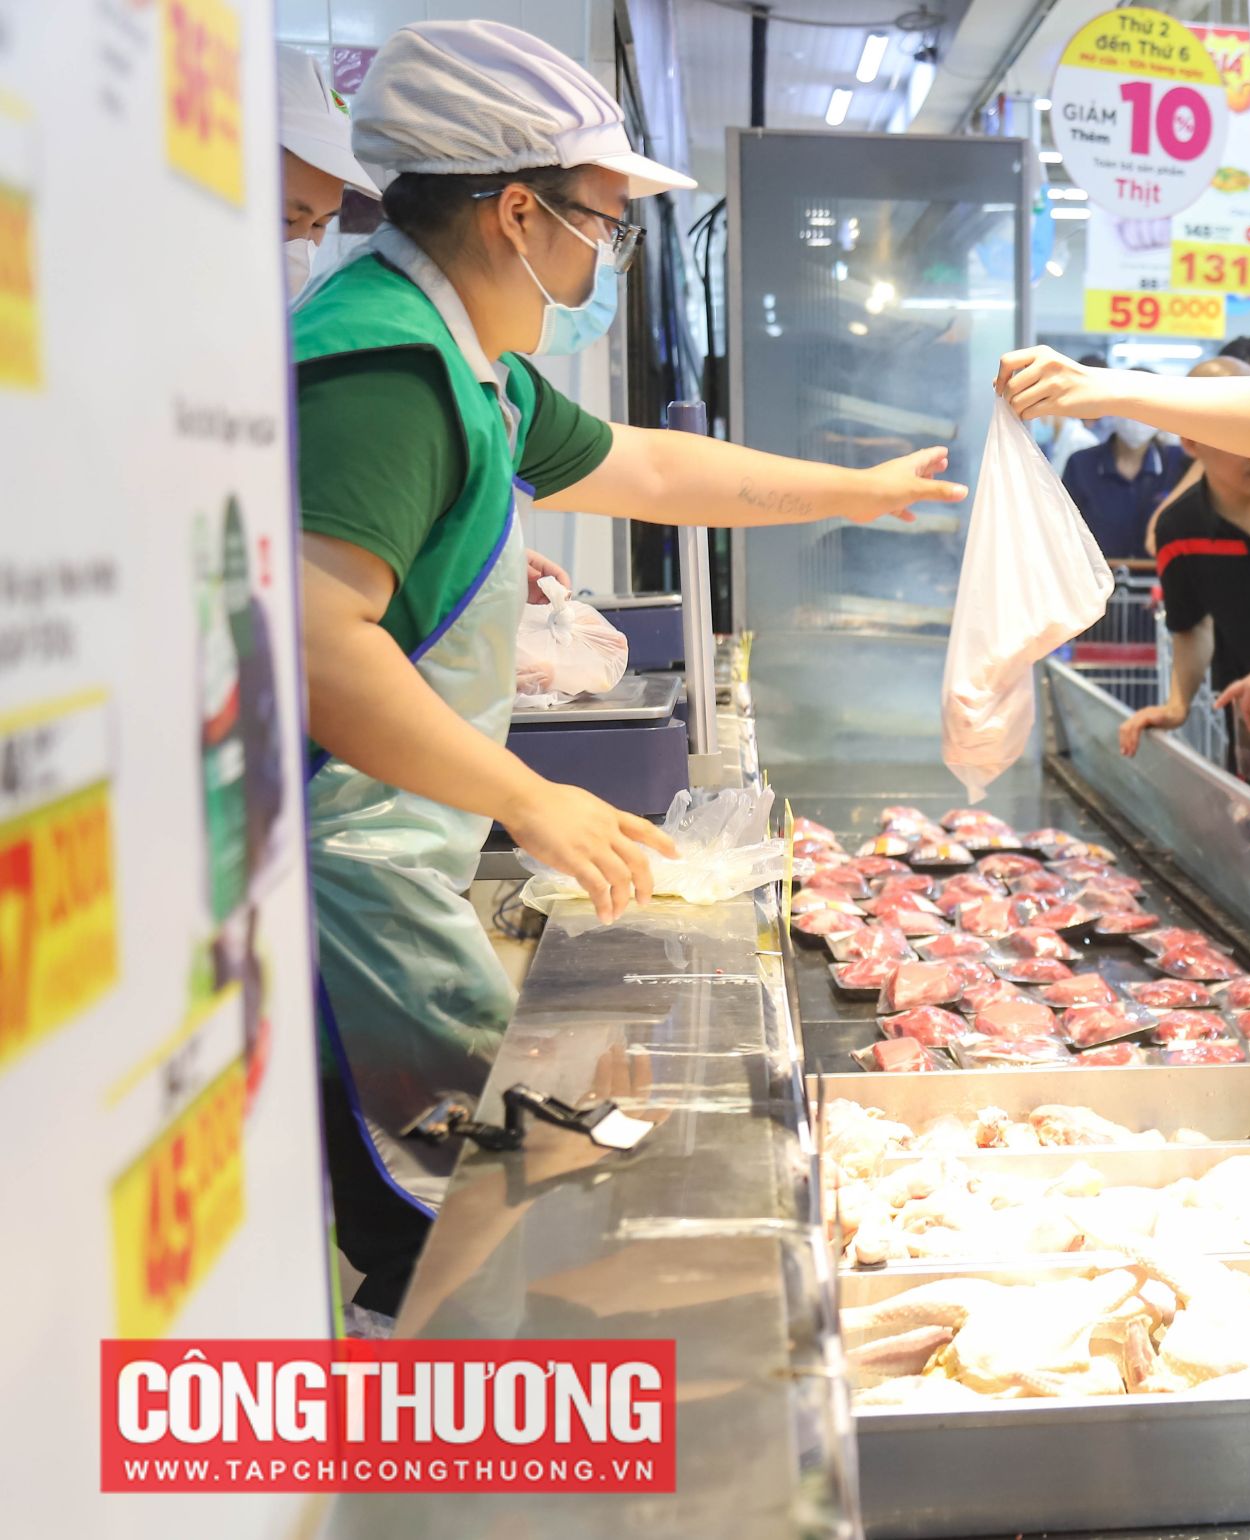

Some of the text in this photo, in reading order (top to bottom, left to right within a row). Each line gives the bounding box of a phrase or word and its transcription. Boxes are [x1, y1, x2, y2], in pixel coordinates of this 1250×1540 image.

[1119, 15, 1170, 37] Thứ 2
[1096, 35, 1190, 62] đến Thứ 6
[1063, 100, 1117, 126] GIẢM
[1070, 127, 1111, 144] Thêm
[1115, 177, 1161, 208] Thịt
